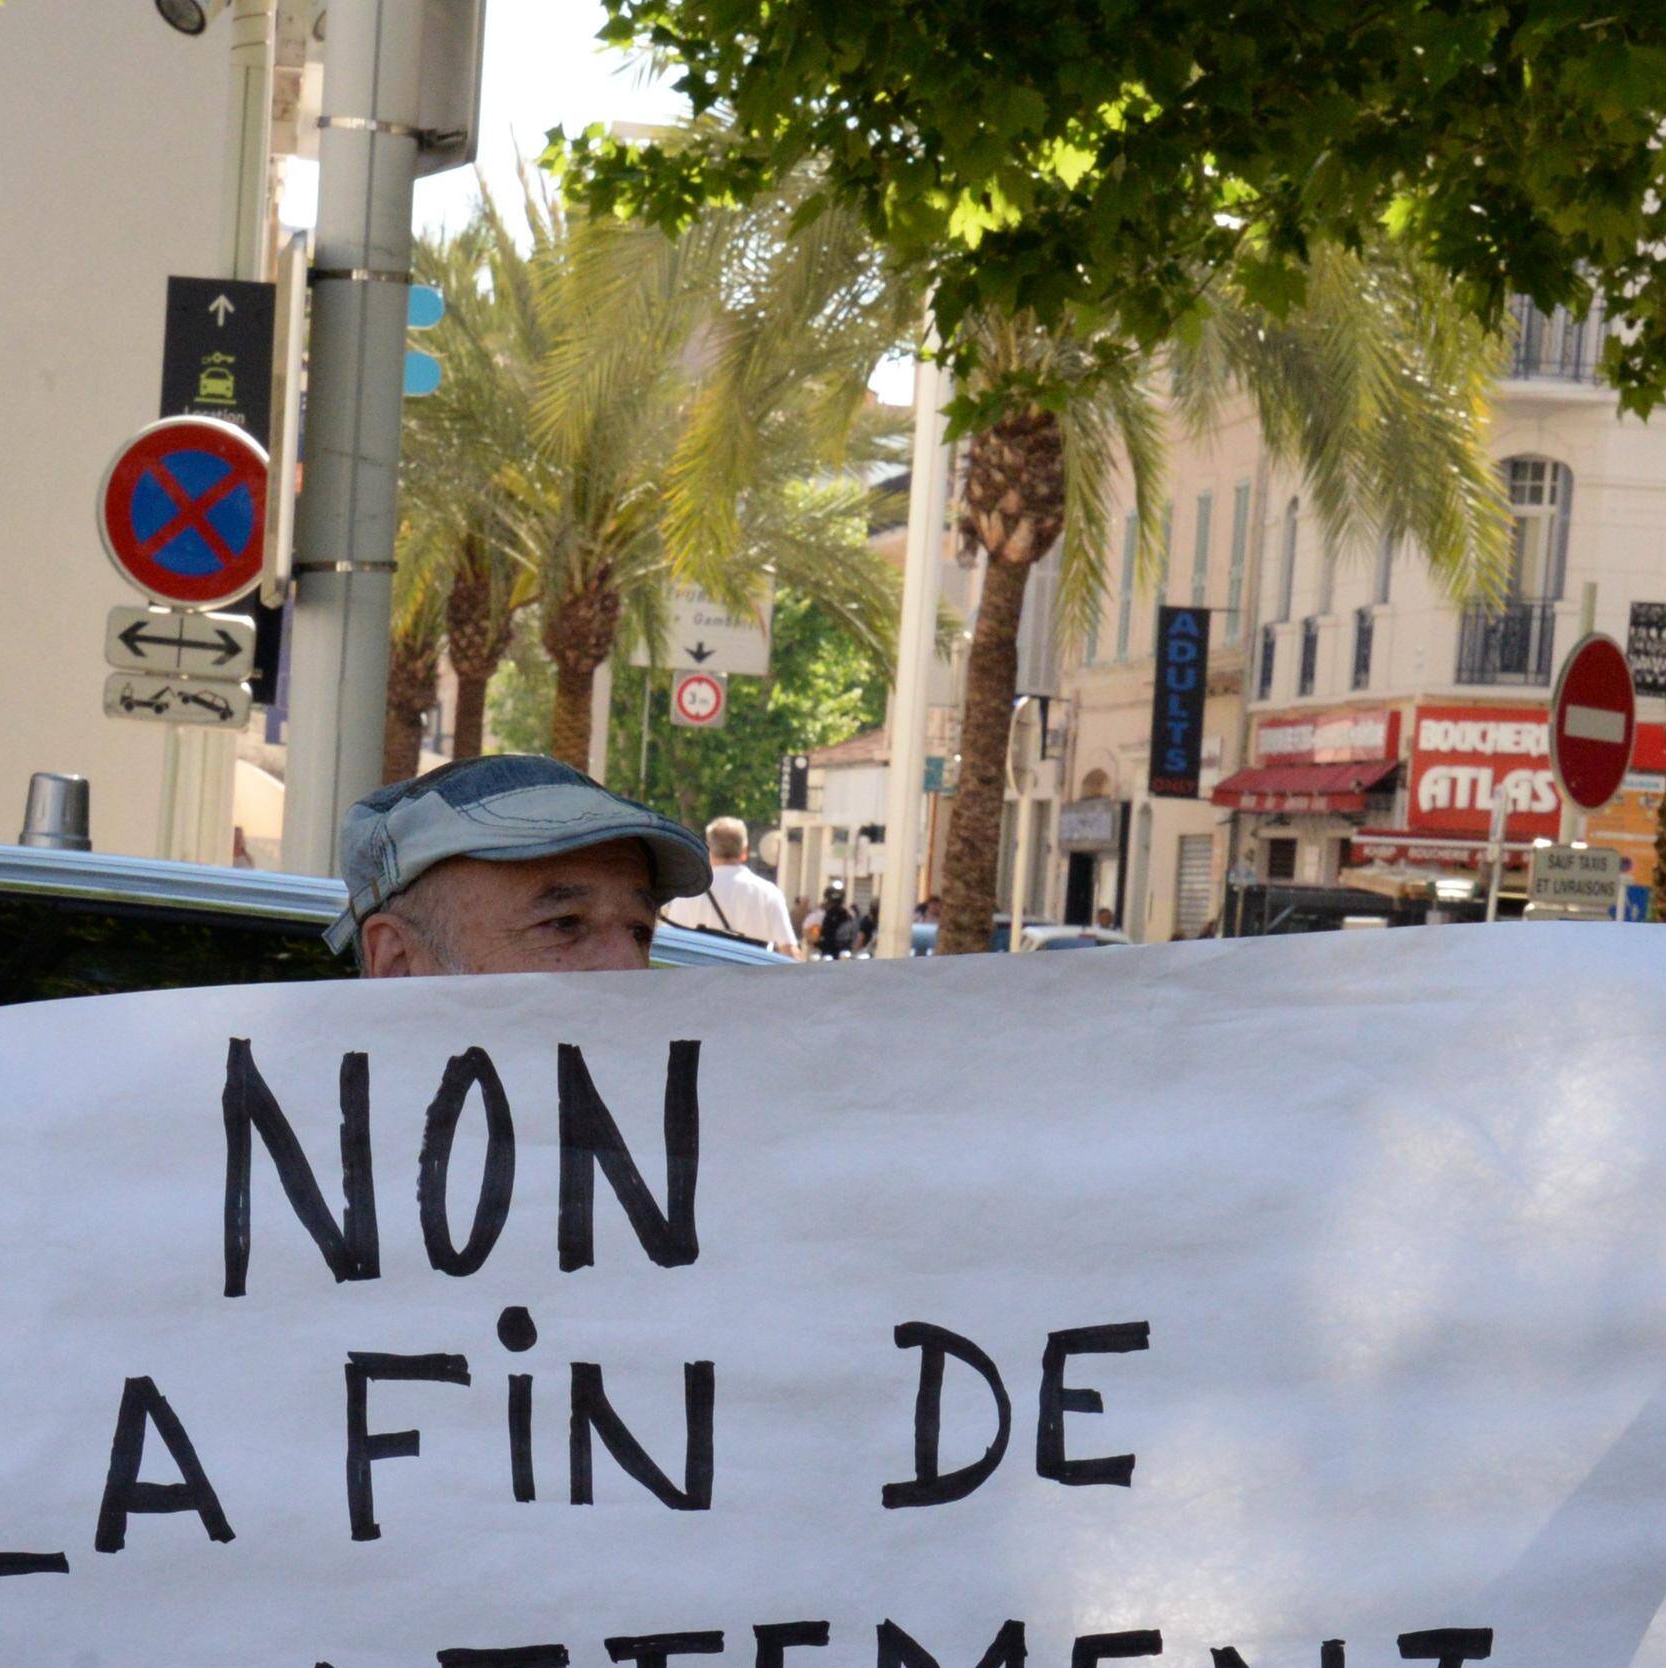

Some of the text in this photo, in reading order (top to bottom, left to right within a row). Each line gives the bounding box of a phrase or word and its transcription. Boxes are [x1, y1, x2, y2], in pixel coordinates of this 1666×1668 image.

[1164, 611, 1199, 773] ADULTS
[1418, 764, 1558, 814] ATLAS
[1536, 878, 1549, 894] ET
[1548, 853, 1608, 871] SAUF TAXIS
[222, 1036, 703, 1298] NON
[881, 1320, 1152, 1510] DE
